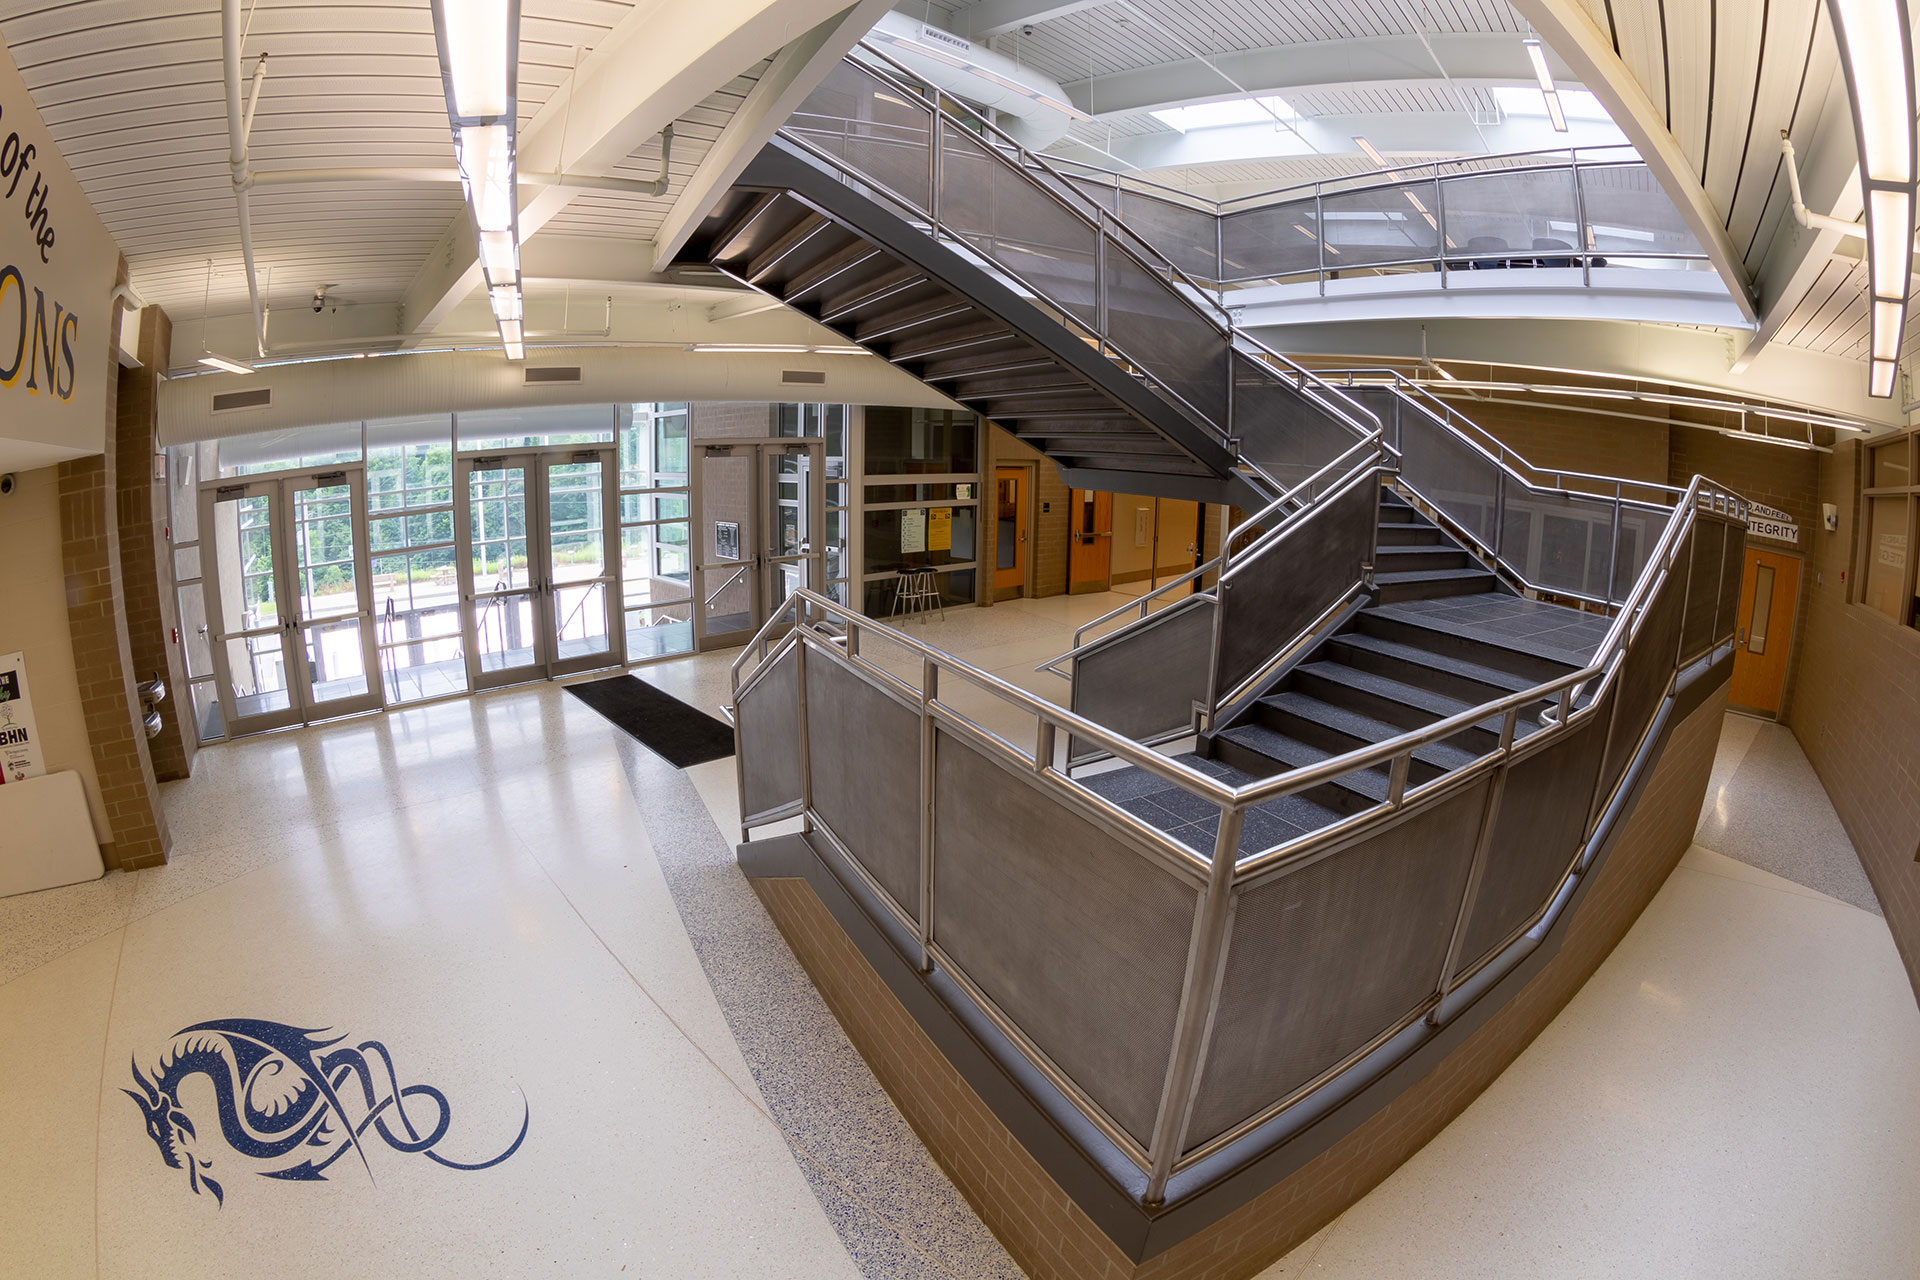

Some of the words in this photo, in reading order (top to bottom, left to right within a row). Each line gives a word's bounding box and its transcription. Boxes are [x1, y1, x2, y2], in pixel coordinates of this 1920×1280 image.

[1, 131, 36, 199] of
[25, 171, 55, 264] the
[0, 264, 79, 402] ONS
[1747, 521, 1798, 539] NTEGRITY
[1755, 505, 1770, 516] AND
